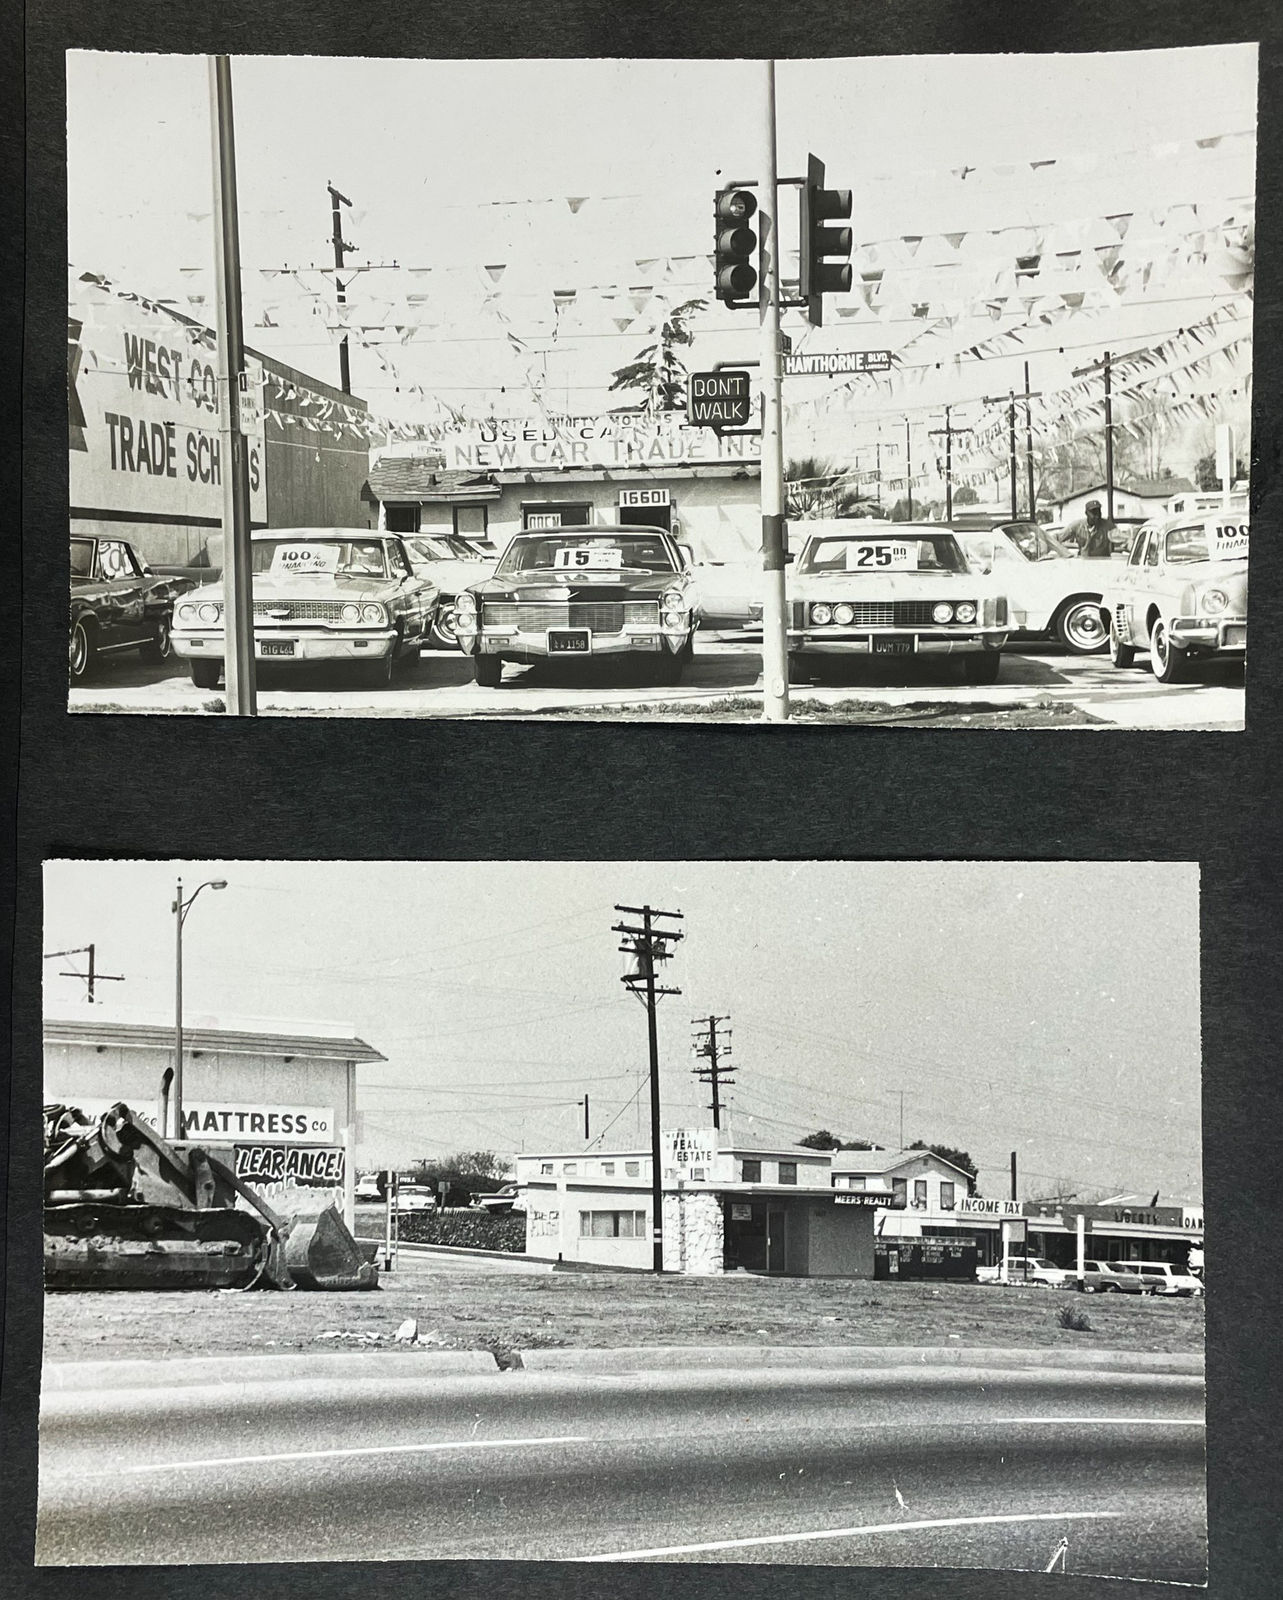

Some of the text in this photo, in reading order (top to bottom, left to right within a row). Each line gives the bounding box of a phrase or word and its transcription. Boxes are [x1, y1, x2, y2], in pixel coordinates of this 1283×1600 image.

[124, 332, 182, 403] WEST
[786, 354, 864, 373] HAWTHORNE
[694, 377, 743, 397] DON'T
[694, 402, 743, 420] WALK
[480, 427, 557, 442] USED
[105, 412, 177, 478] TRADE
[455, 443, 516, 466] NEW
[530, 442, 589, 463] CAR
[609, 438, 704, 460] TRADE
[623, 490, 666, 505] 16601
[563, 551, 590, 566] 15
[181, 1110, 307, 1134] MATTRESS
[673, 1140, 698, 1150] REAL
[677, 1151, 712, 1162] ESTATE
[834, 1195, 891, 1206] MEERS REALTY
[961, 1199, 1020, 1214] INCOME TAX
